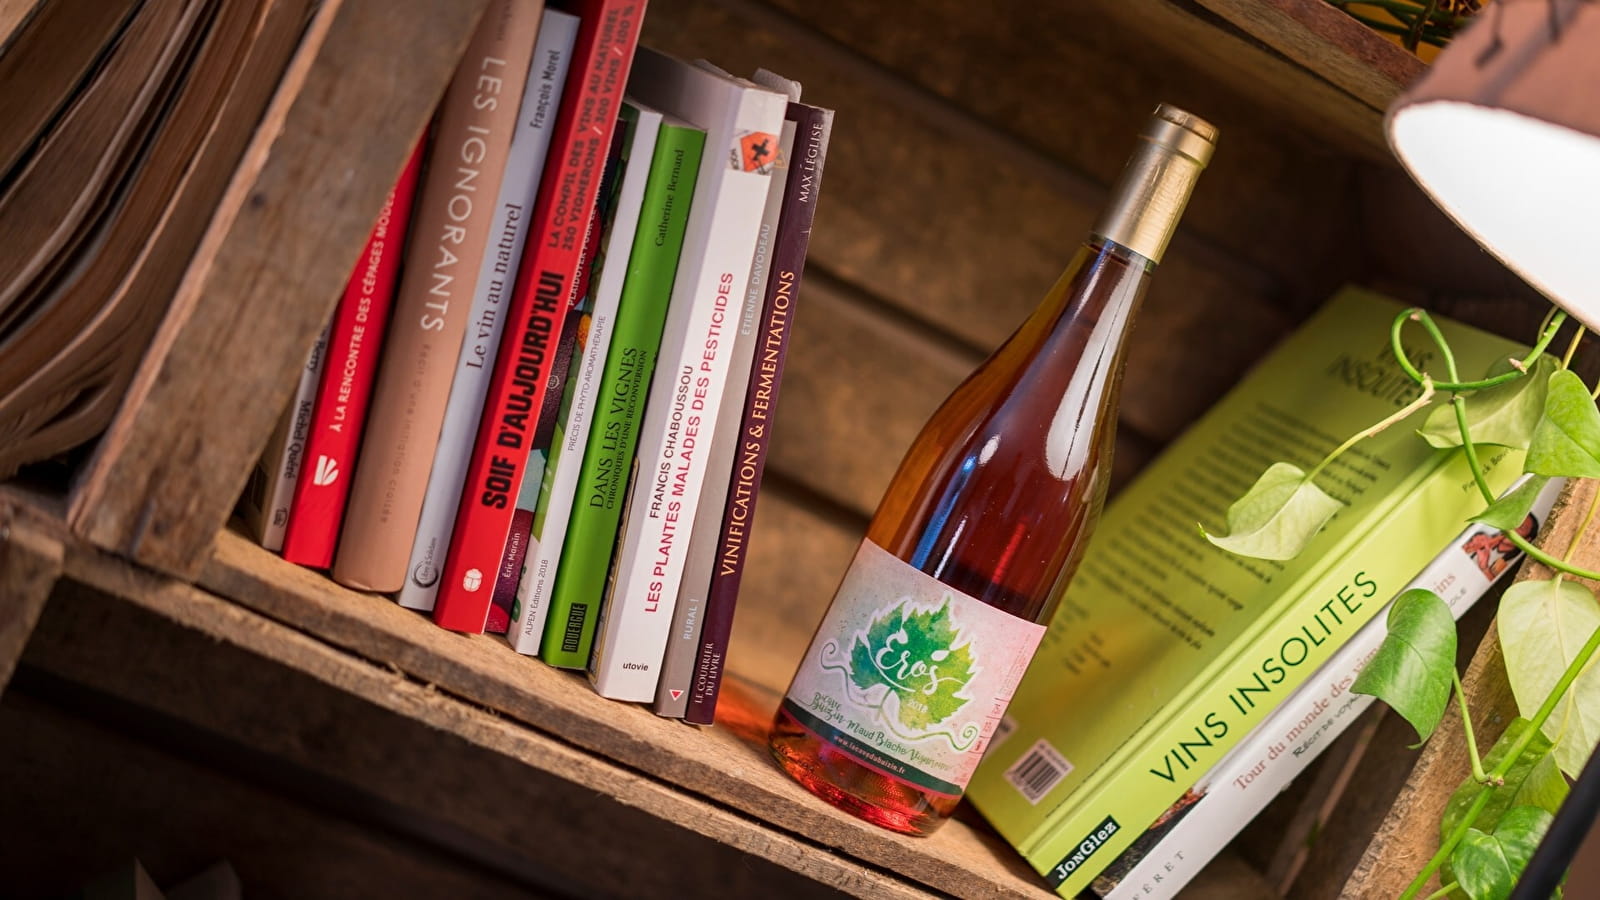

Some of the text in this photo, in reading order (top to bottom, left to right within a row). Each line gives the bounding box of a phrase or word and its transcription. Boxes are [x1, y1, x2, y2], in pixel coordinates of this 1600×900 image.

[529, 50, 560, 128] François Morel
[548, 9, 619, 248] LA COMPIL DES VINS AU NATUREL
[562, 226, 576, 250] 250
[570, 138, 600, 222] VIGNERONS
[595, 99, 610, 123] 300
[604, 59, 620, 93] VINS
[798, 124, 824, 202] MAX LÉGLISE
[421, 58, 506, 333] LES IGNORANTS
[655, 149, 685, 247] Catherine Bernard
[363, 241, 384, 295] CÉPAGES
[466, 203, 523, 369] Le vin au naturel
[741, 224, 770, 336] ÉTIENNE DAVODEAU
[356, 298, 371, 321] DES
[338, 326, 365, 402] RENCONTRE
[482, 271, 564, 509] SOIF D'AUJOURD'HUI
[330, 424, 342, 432] À
[335, 406, 346, 420] LA
[567, 424, 580, 451] PRÉCIS
[574, 411, 583, 421] DE
[590, 348, 637, 508] DANS LES VIGNES
[606, 350, 647, 510] CHRONIQUES D'UNE RECONVERSION
[645, 273, 733, 612] LES PLANTES MALADES DES PESTICIDES
[649, 366, 693, 518] FRANCIS CHABOUSSOU
[721, 271, 794, 575] VINIFICATIONS & FERMENTATIONS
[502, 533, 520, 578] Éric Morain
[525, 559, 548, 635] ALPEN Éditions 2018
[563, 605, 585, 650] ROUERGUE
[683, 606, 698, 640] RURAL
[623, 663, 648, 671] utovie
[695, 643, 714, 703] LE COURRIER
[705, 654, 720, 696] DU LIVRE
[876, 628, 945, 695] Eros
[1150, 712, 1228, 782] VINS
[1229, 572, 1377, 715] INSOLITES
[1233, 760, 1266, 790] Tour
[1268, 742, 1286, 760] du
[1286, 698, 1330, 743] monde
[1330, 676, 1352, 698] des
